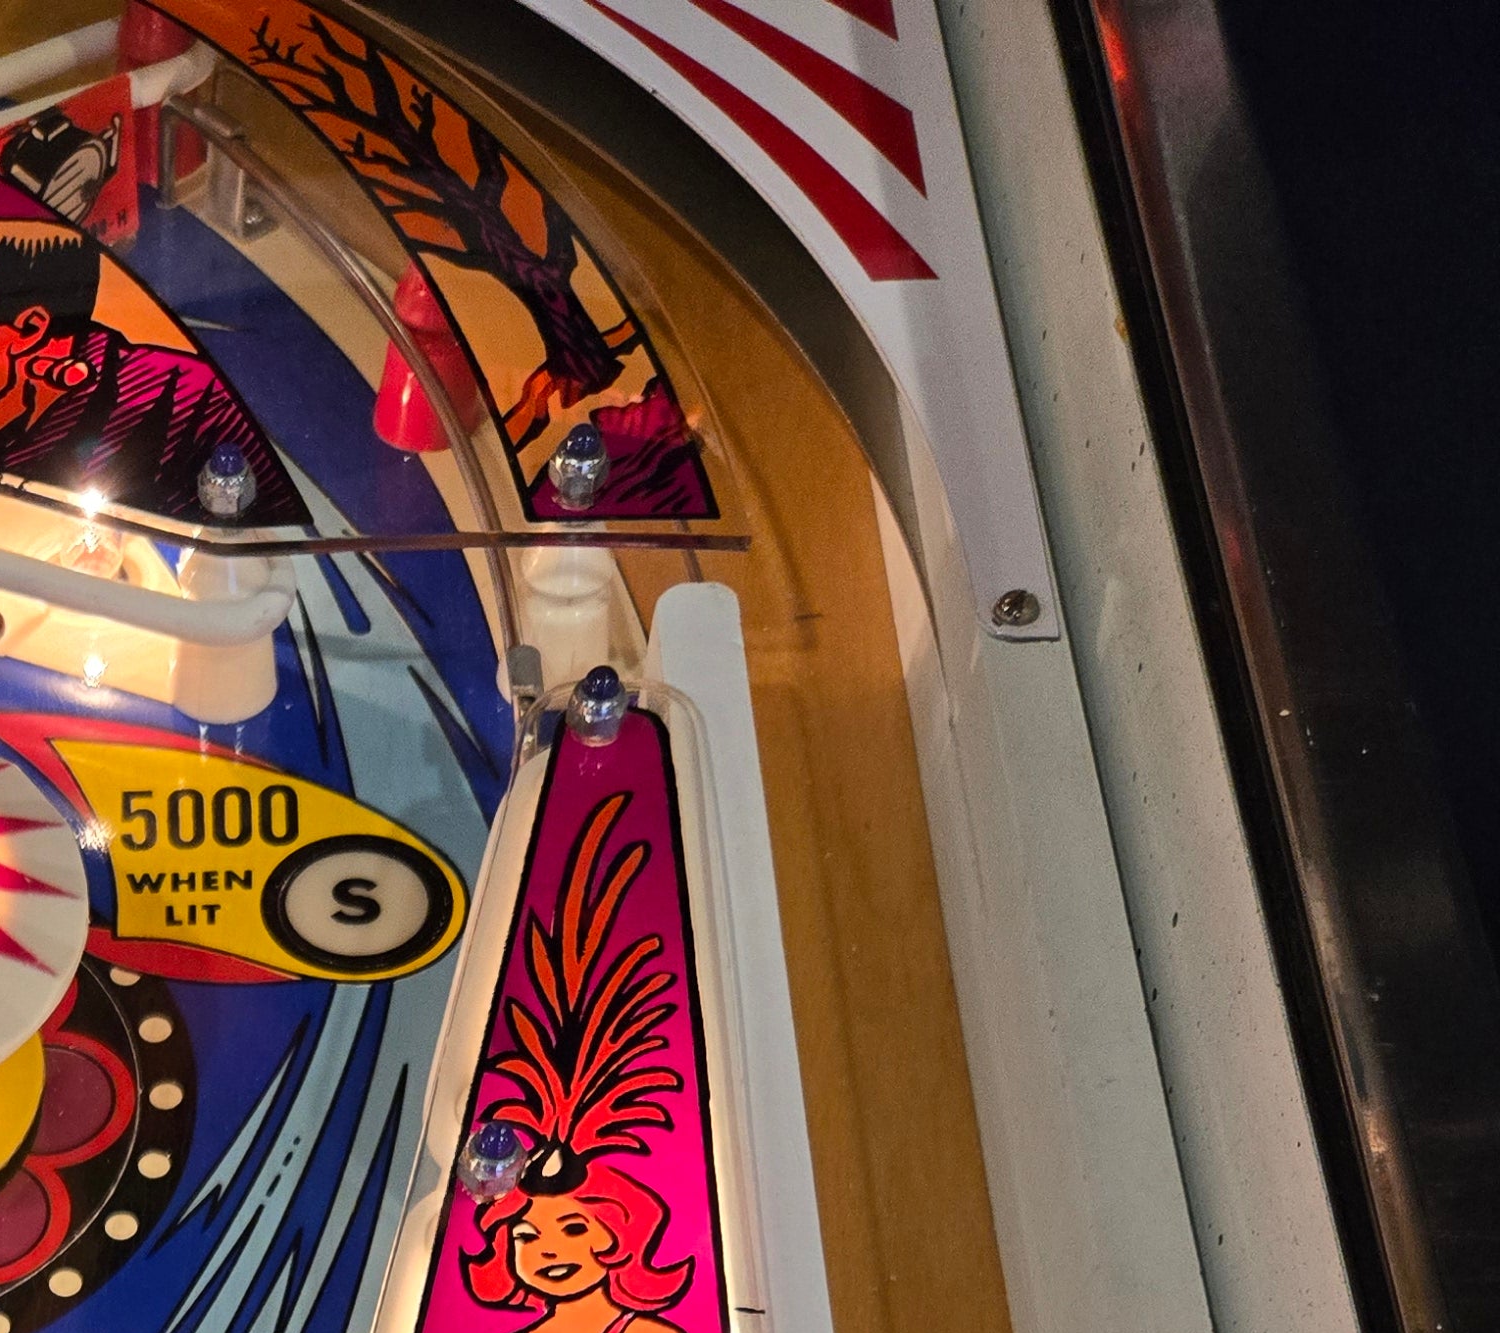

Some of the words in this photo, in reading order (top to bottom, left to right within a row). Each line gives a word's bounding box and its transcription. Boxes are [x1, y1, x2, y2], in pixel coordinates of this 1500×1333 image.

[119, 784, 299, 852] 5000
[126, 869, 254, 895] WHEN
[164, 903, 222, 927] LIT
[329, 877, 383, 926] S
